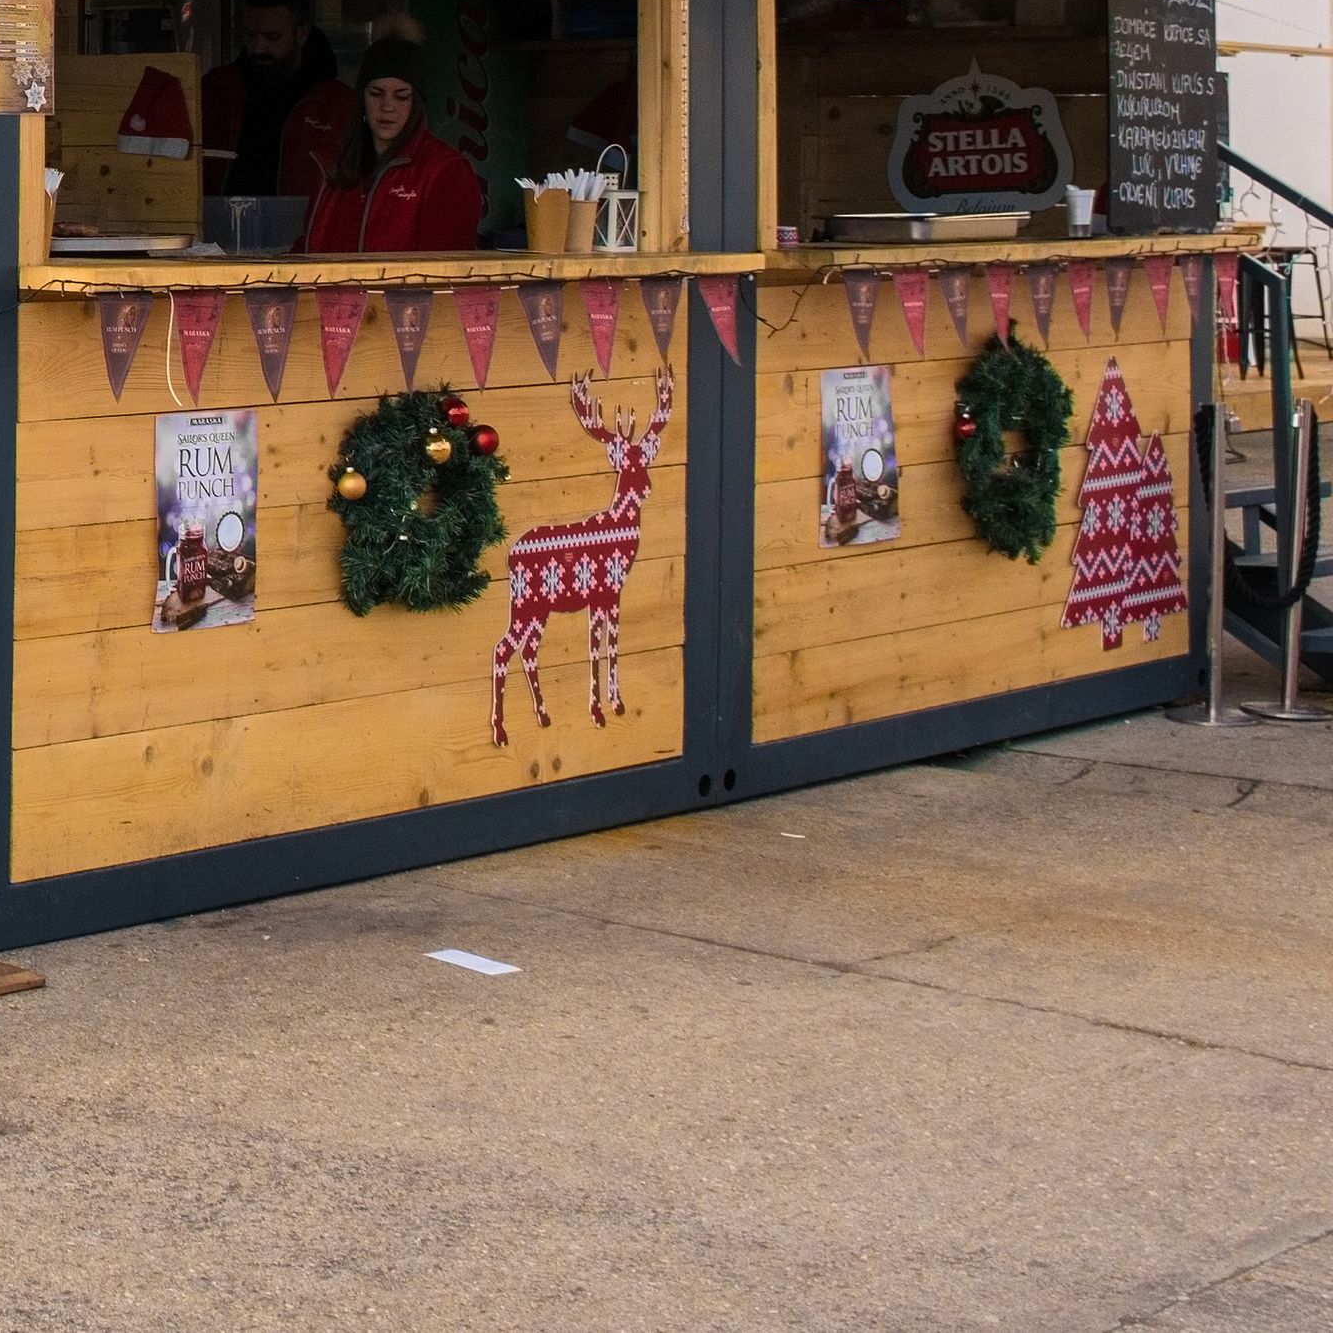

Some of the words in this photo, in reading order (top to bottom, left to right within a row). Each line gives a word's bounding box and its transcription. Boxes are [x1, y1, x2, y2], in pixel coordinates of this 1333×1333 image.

[927, 127, 1027, 153] STELLA
[927, 152, 1029, 178] ARTOIS
[836, 396, 874, 422] RUM
[191, 417, 223, 426] MARASKA
[836, 422, 874, 440] PUNCH
[209, 432, 235, 444] QUEEN
[179, 446, 234, 478] RUM
[178, 478, 235, 501] PUNCH
[184, 559, 205, 575] RUM
[184, 571, 206, 584] PUNCH
